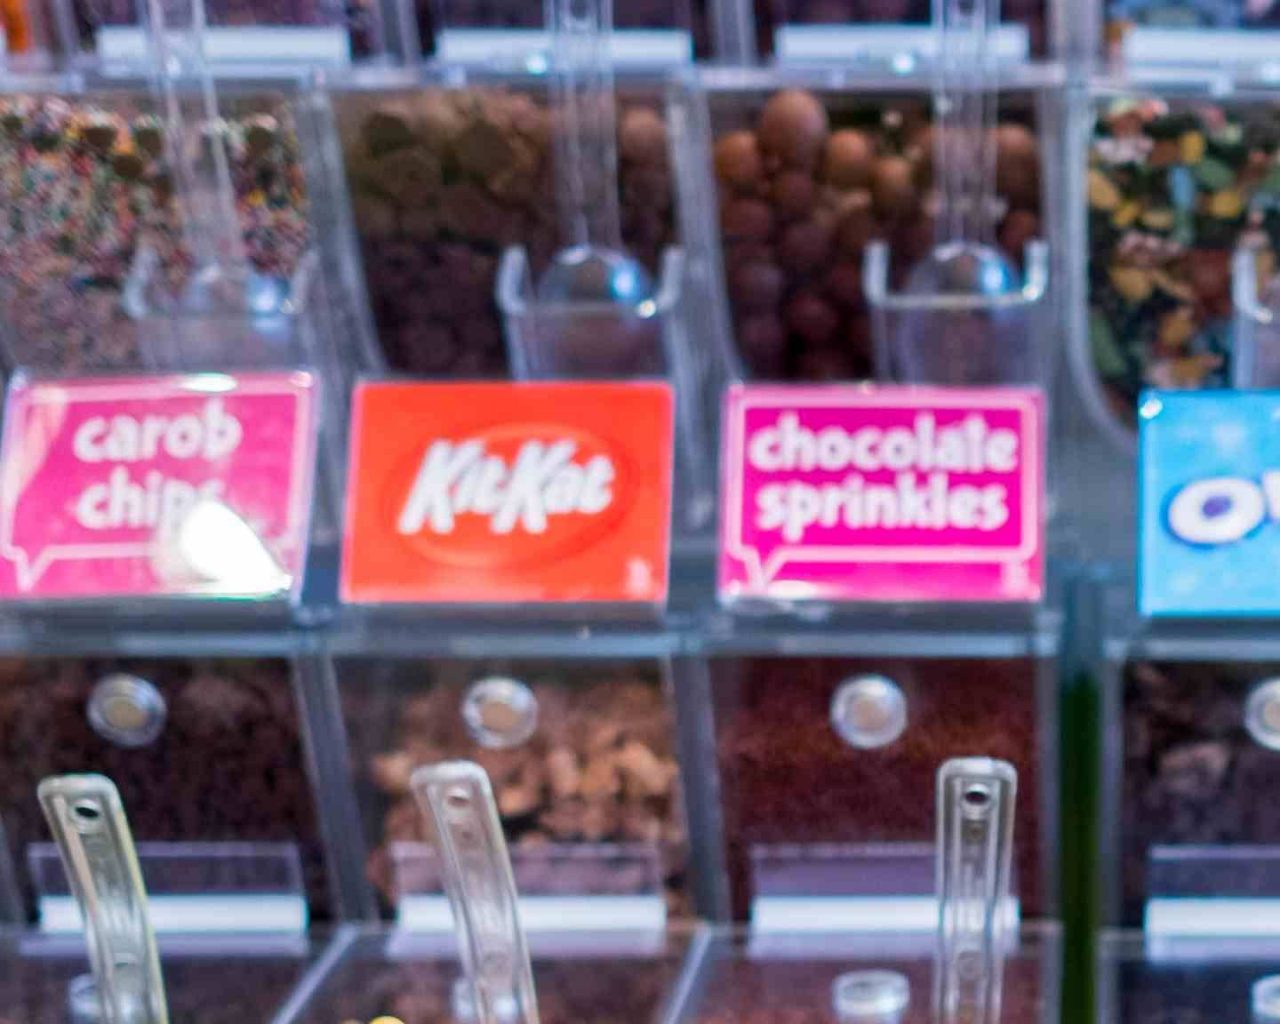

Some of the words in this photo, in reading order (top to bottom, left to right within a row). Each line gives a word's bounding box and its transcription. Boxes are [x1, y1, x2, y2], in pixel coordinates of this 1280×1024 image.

[73, 396, 243, 463] carob
[750, 409, 1019, 472] chocolate
[755, 470, 1009, 542] sprinkles
